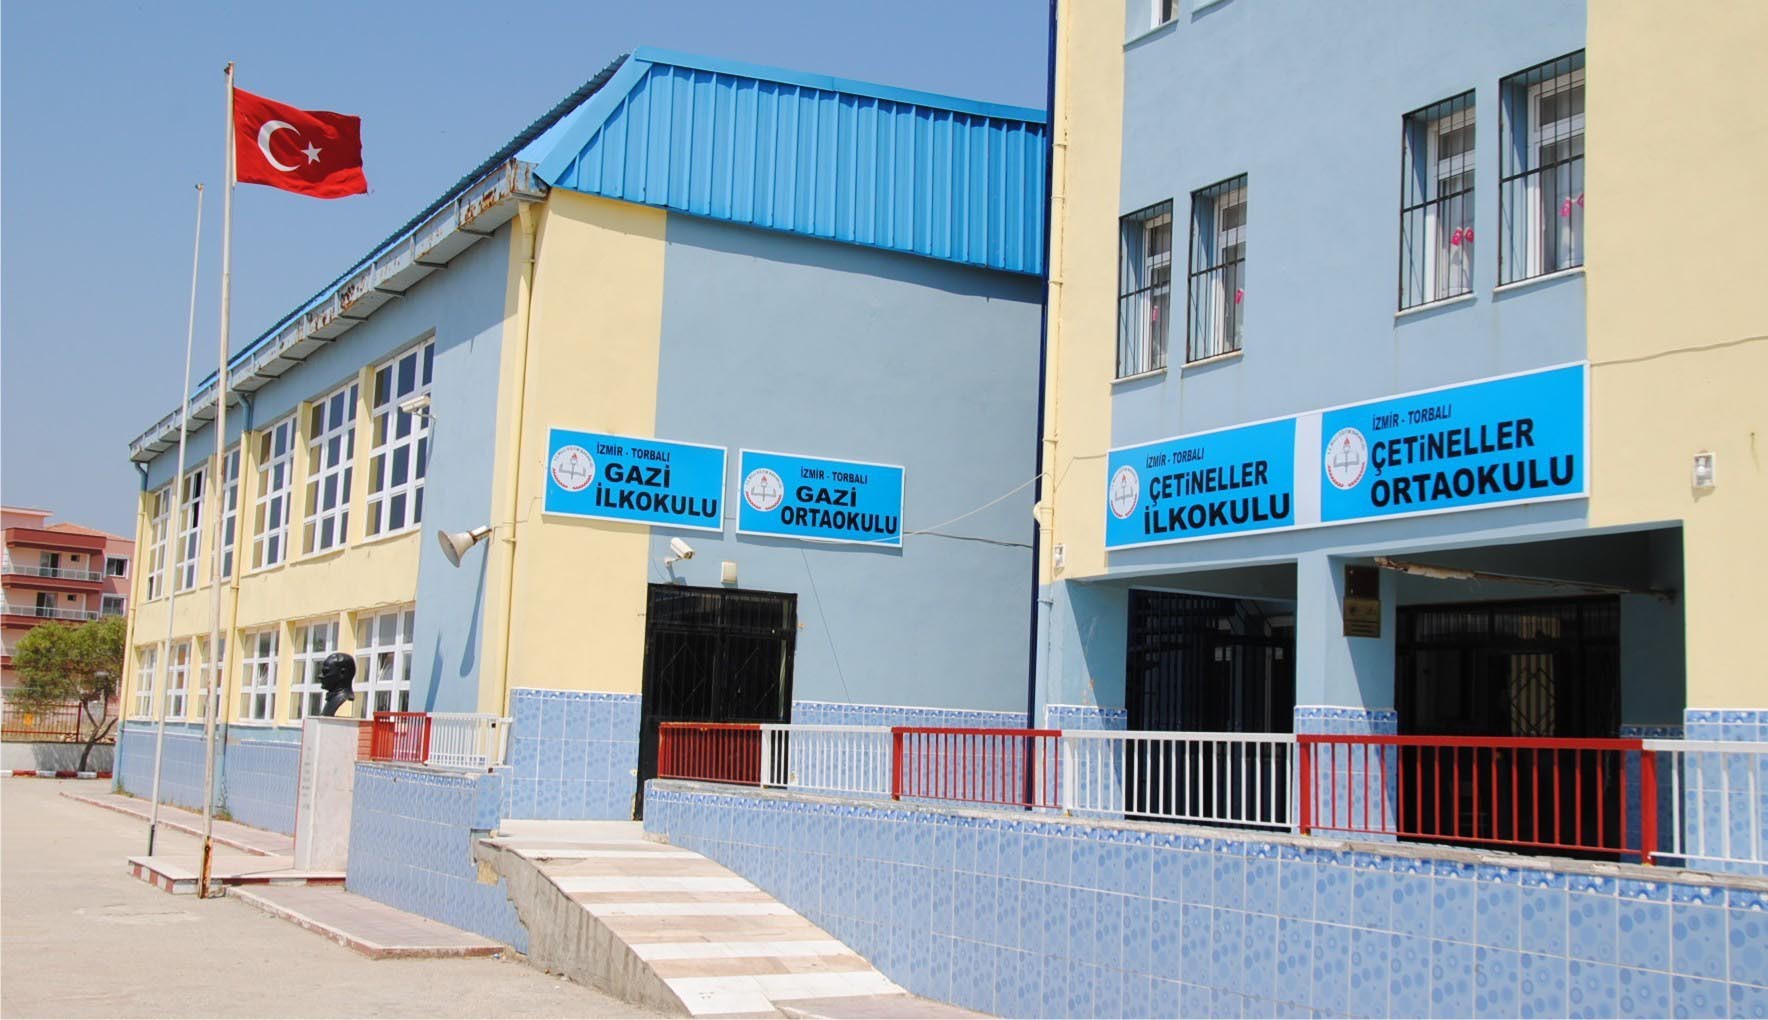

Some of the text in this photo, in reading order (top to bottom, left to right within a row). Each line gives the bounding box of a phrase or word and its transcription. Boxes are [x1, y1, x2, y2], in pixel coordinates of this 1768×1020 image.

[1372, 412, 1399, 431] İZMİR
[1408, 403, 1452, 425] TORBALI
[597, 441, 623, 457] İZMİR
[631, 447, 670, 462] TORBALI
[1146, 452, 1167, 469] İZMİR
[1173, 447, 1205, 464] TORBALI
[604, 463, 671, 489] GAZİ
[800, 465, 825, 480] İZMİR
[832, 471, 868, 485] TORBALI
[1370, 454, 1574, 508] ORTAOKULU
[595, 482, 718, 518] İLKOKULU
[795, 485, 857, 508] GAZİ
[780, 505, 898, 535] ORTAOKULU
[1144, 492, 1290, 535] İLKOKULU
